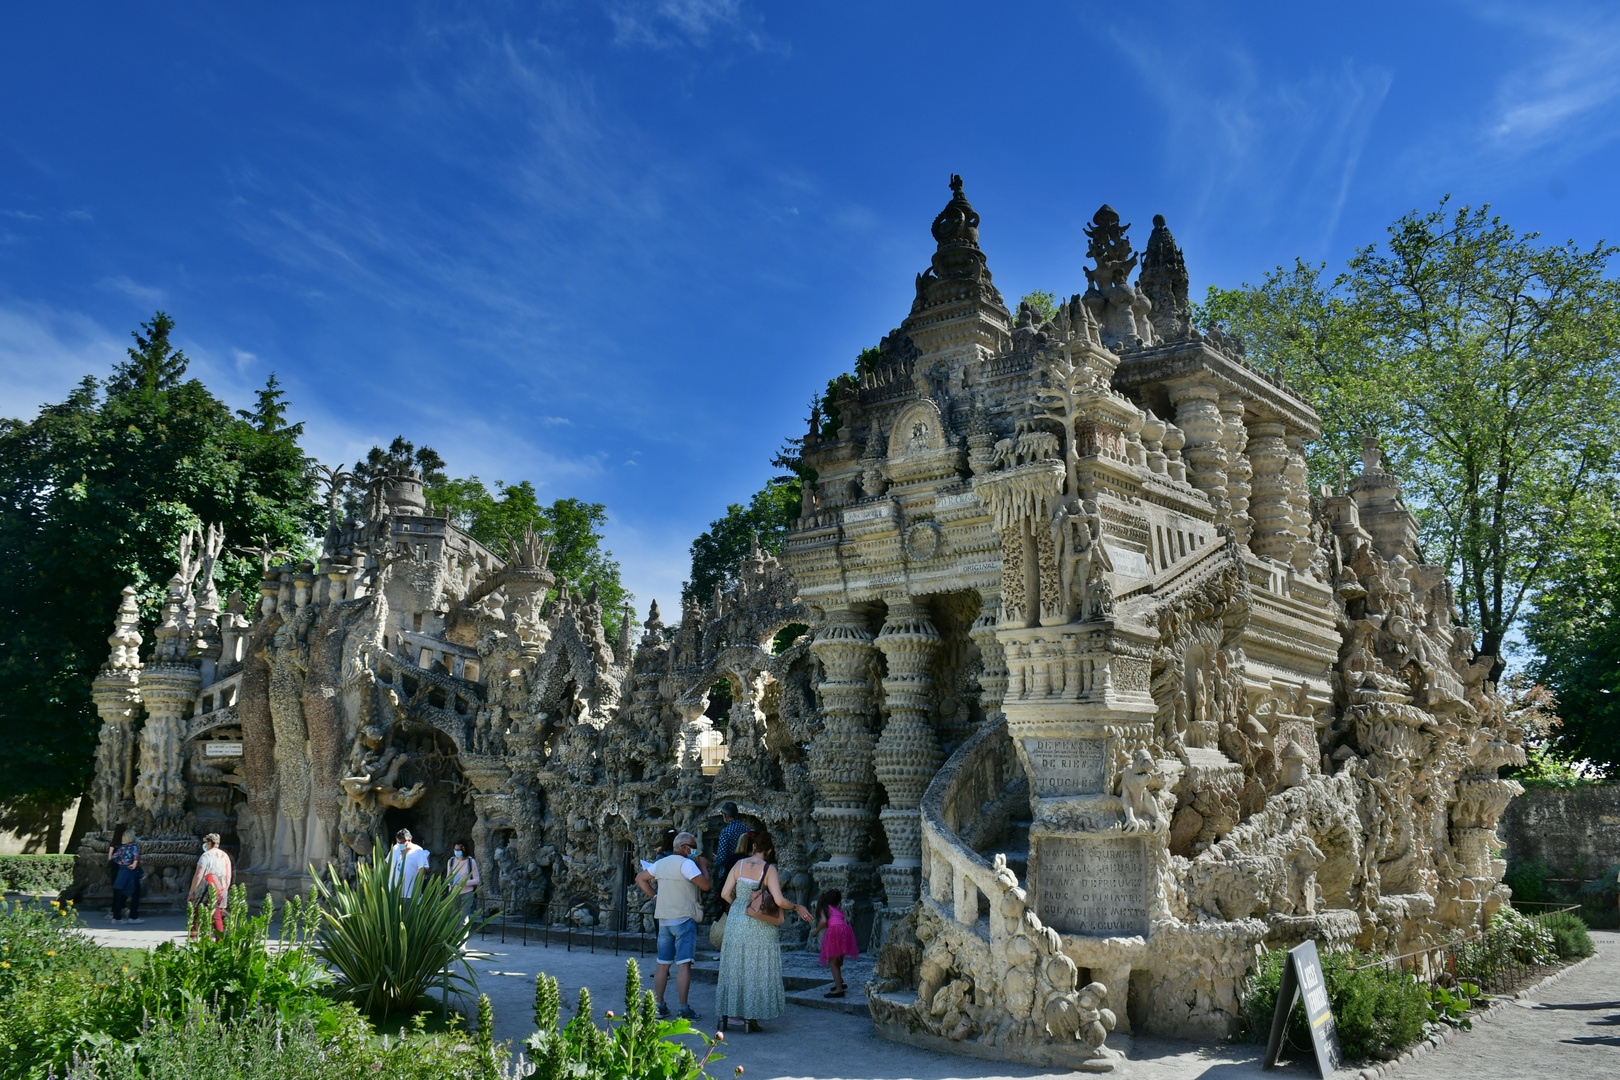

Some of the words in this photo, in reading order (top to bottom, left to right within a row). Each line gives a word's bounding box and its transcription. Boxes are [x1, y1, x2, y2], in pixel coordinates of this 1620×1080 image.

[962, 562, 998, 572] ORIGINAL
[1037, 741, 1092, 750] DEFENSE
[1042, 759, 1056, 768] DE
[1061, 760, 1087, 768] RIEN
[1037, 777, 1094, 787] TOUCHER
[1052, 849, 1084, 857] MILLE
[1056, 864, 1090, 873] MILLE
[1057, 878, 1075, 887] ANS
[1044, 891, 1069, 900] PLUS
[1082, 894, 1142, 903] OPINIATRE
[1044, 905, 1063, 915] QUE
[1067, 907, 1087, 916] MOI
[1096, 908, 1107, 917] SE
[1111, 908, 1146, 917] METTE
